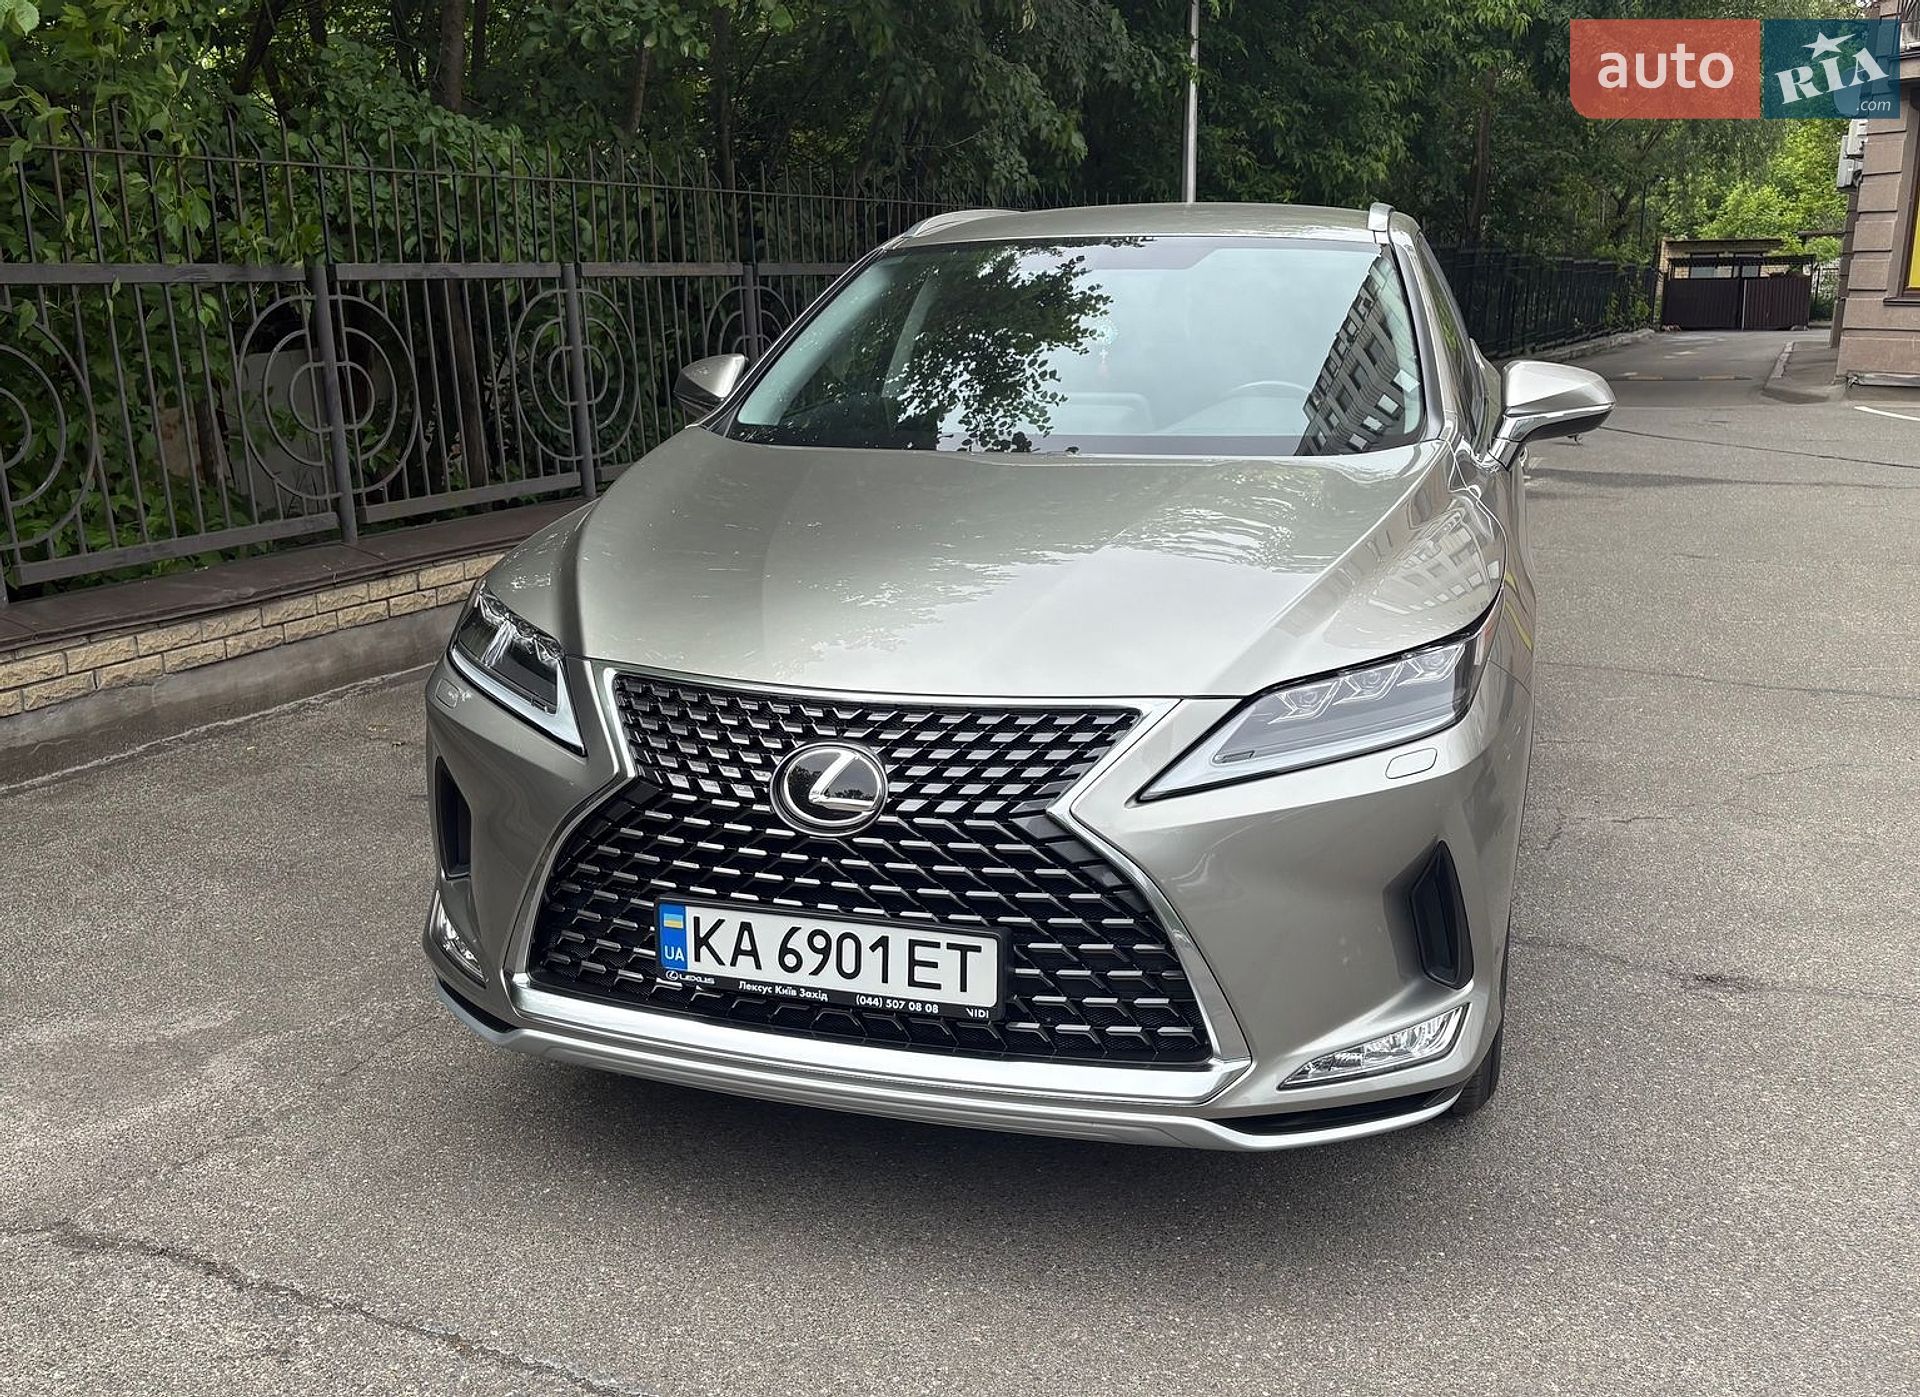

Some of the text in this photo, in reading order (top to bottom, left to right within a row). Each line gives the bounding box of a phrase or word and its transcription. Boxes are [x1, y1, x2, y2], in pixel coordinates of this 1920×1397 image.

[664, 945, 685, 962] UA
[693, 916, 982, 992] KA 6901 ET
[679, 973, 715, 985] LEXUS
[738, 981, 829, 1002] Лексус Київ Захід
[856, 994, 939, 1014] (044) 507 08 08
[965, 1007, 989, 1019] VIDI
